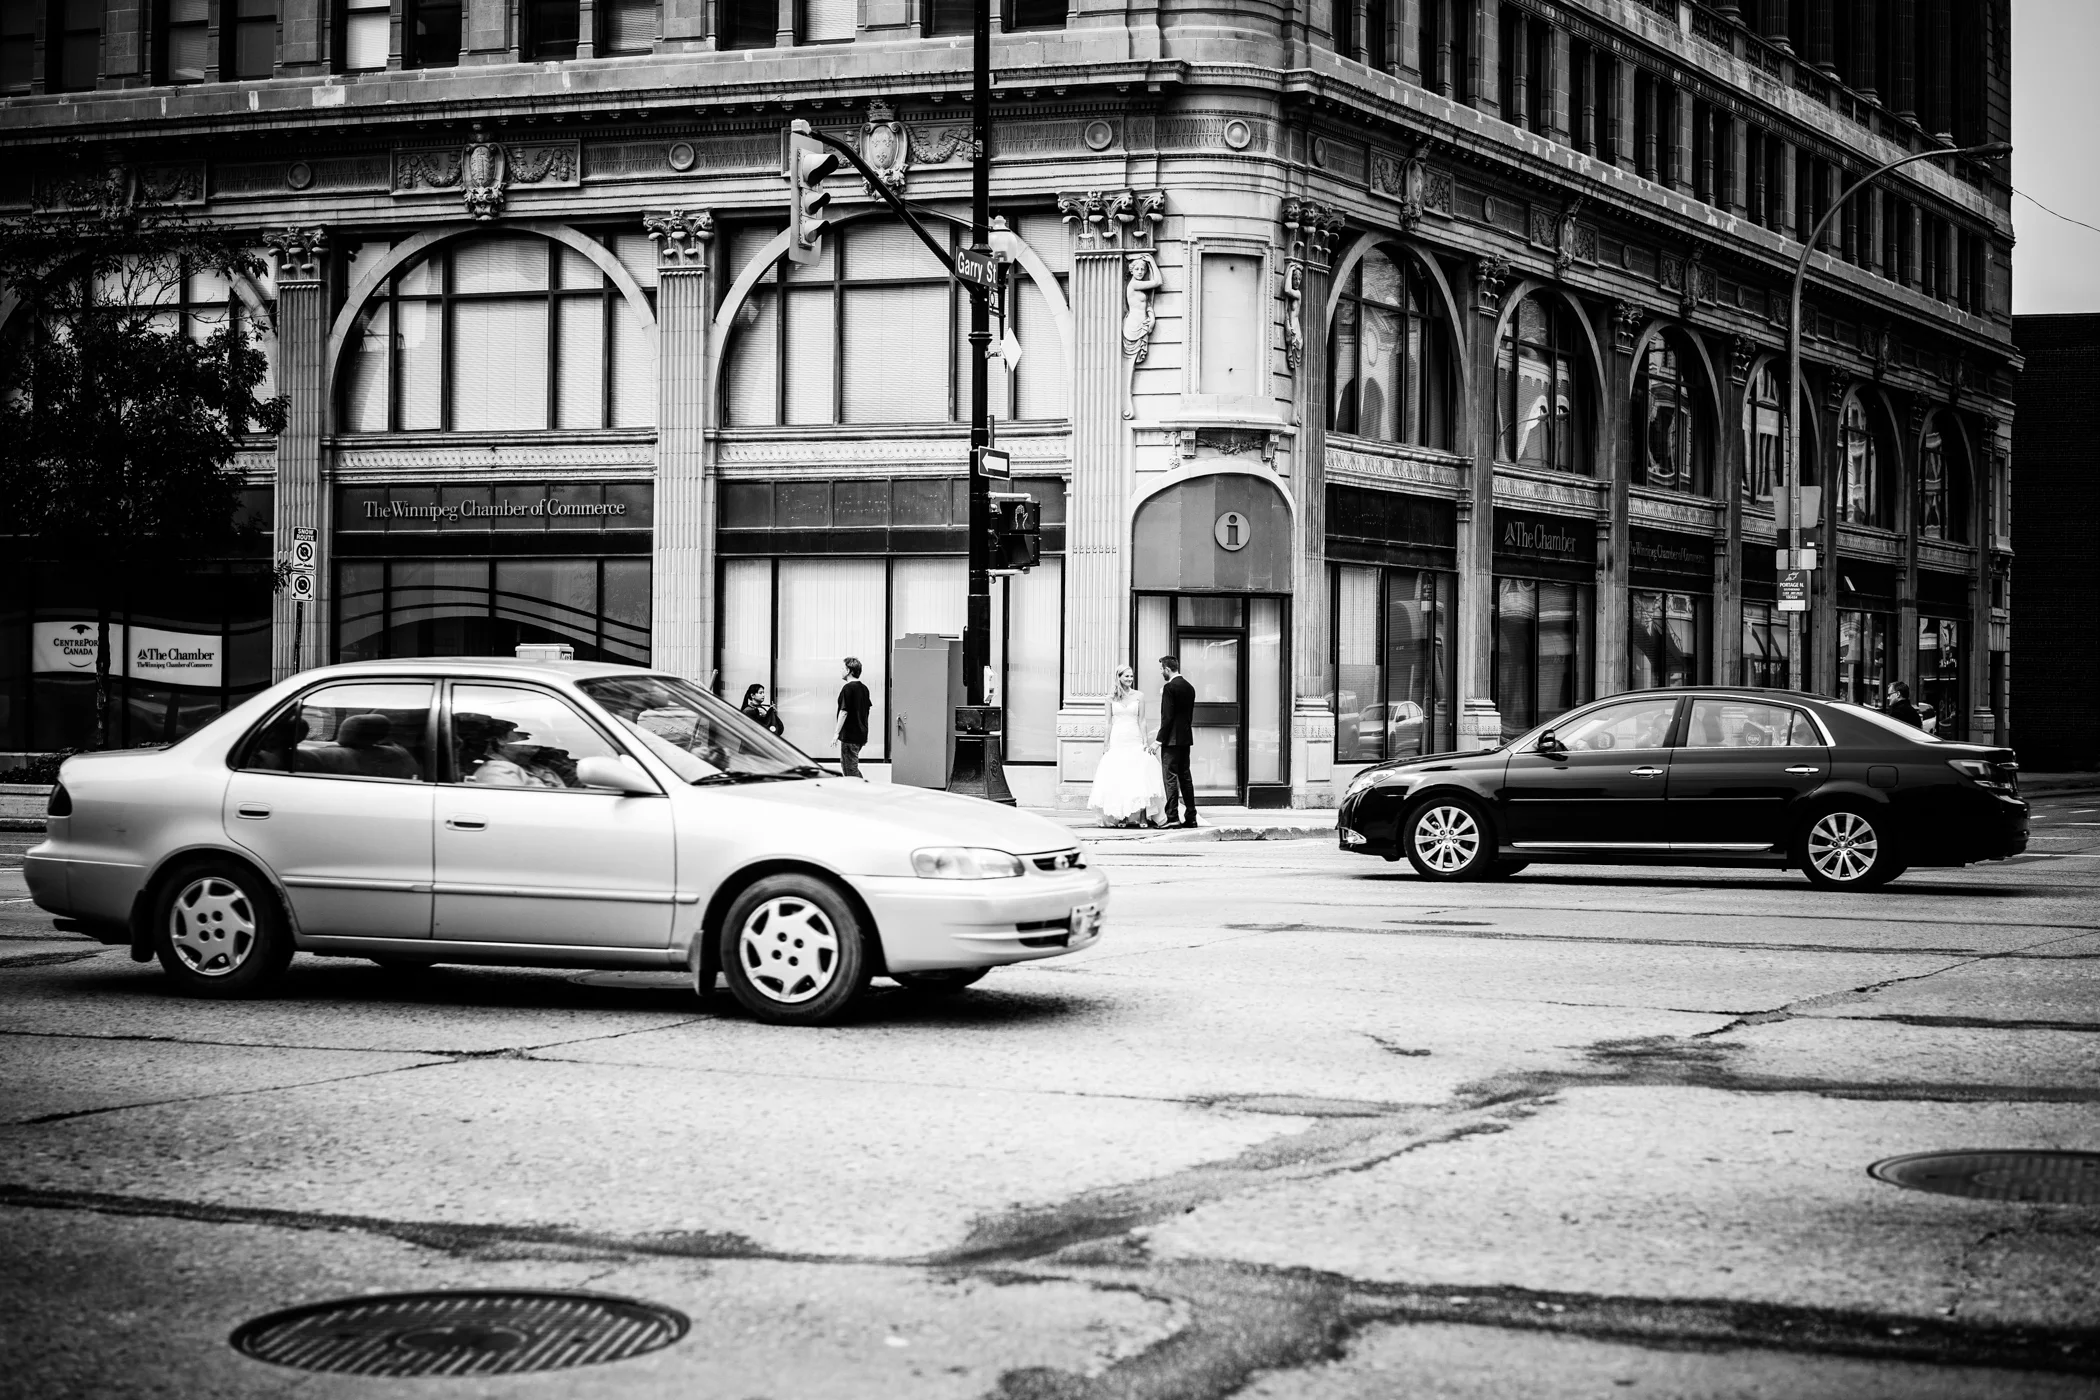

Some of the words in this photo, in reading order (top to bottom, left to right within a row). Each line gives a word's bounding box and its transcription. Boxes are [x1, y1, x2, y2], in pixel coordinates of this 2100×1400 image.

[957, 251, 983, 284] Garry
[986, 260, 997, 284] St
[364, 501, 391, 519] The
[391, 500, 458, 521] Winnipeg
[461, 500, 529, 518] Chamber
[530, 499, 546, 517] of
[547, 498, 626, 516] Commerce
[1515, 521, 1533, 549] The
[1534, 523, 1577, 553] Chamber
[53, 637, 99, 647] CENTREPOR
[63, 646, 93, 655] CANADA
[147, 648, 167, 661] The
[168, 648, 214, 661] Chamber
